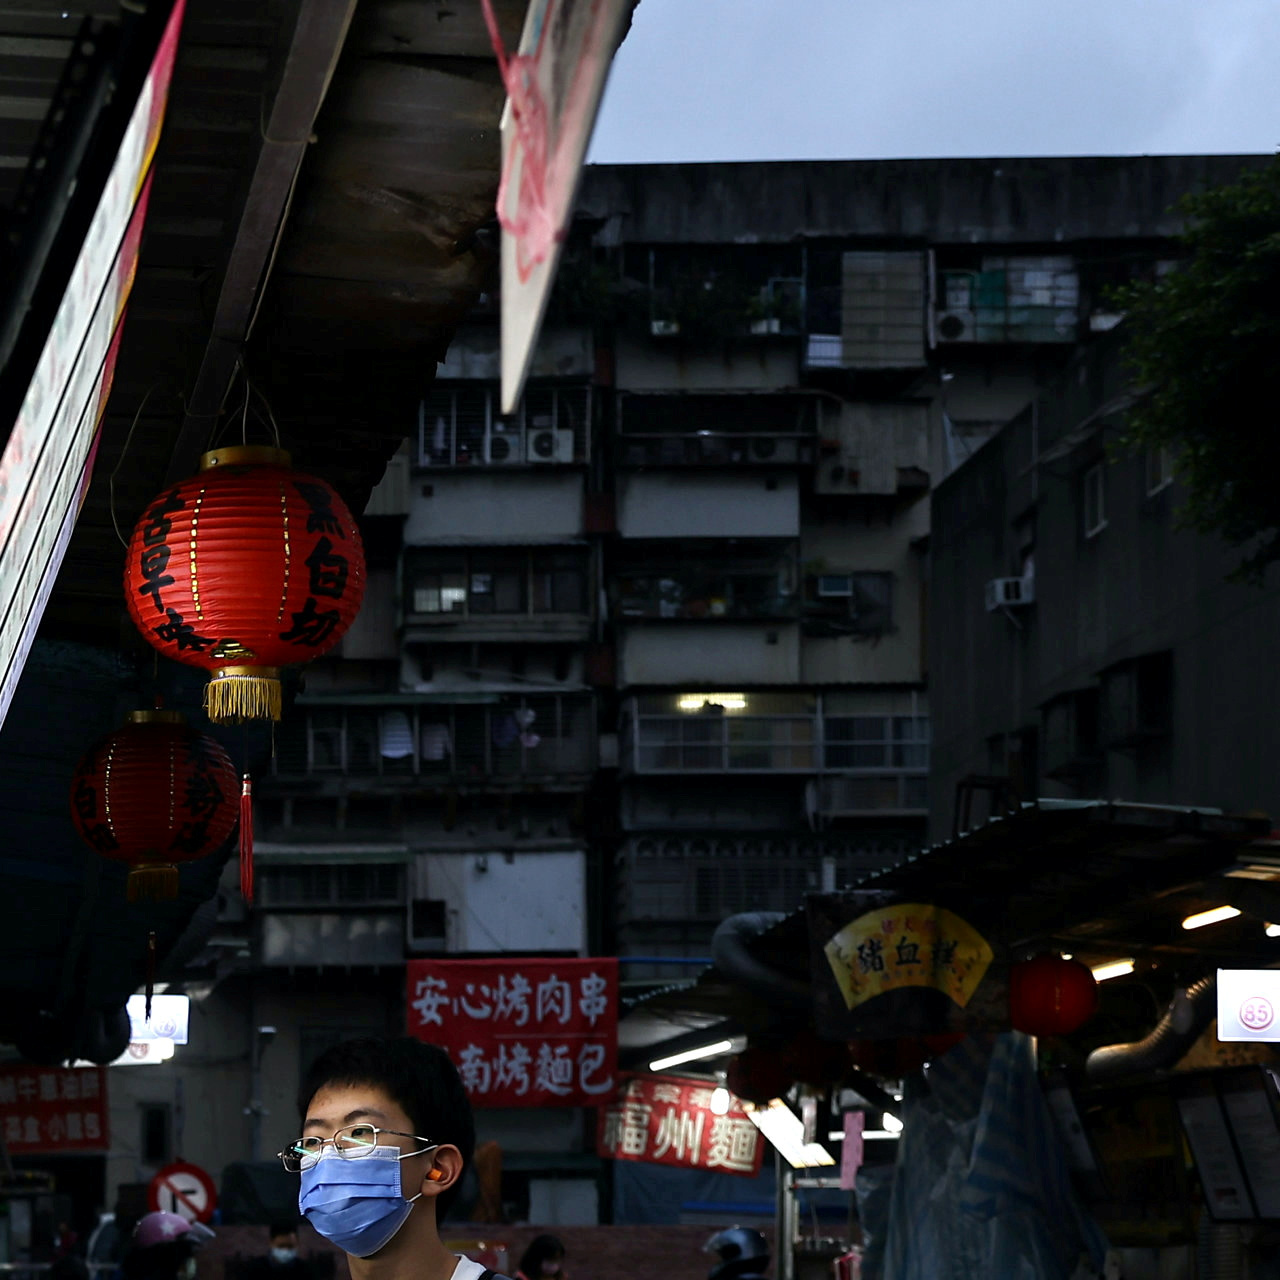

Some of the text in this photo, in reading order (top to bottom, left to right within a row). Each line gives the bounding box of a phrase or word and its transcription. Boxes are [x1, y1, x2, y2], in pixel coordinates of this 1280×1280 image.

[139, 489, 218, 653] 古早味
[279, 482, 351, 647] 黑白切
[411, 972, 609, 1028] 安心烤肉串
[443, 1041, 615, 1097] 南烤麵包
[603, 1103, 759, 1173] 福州麵
